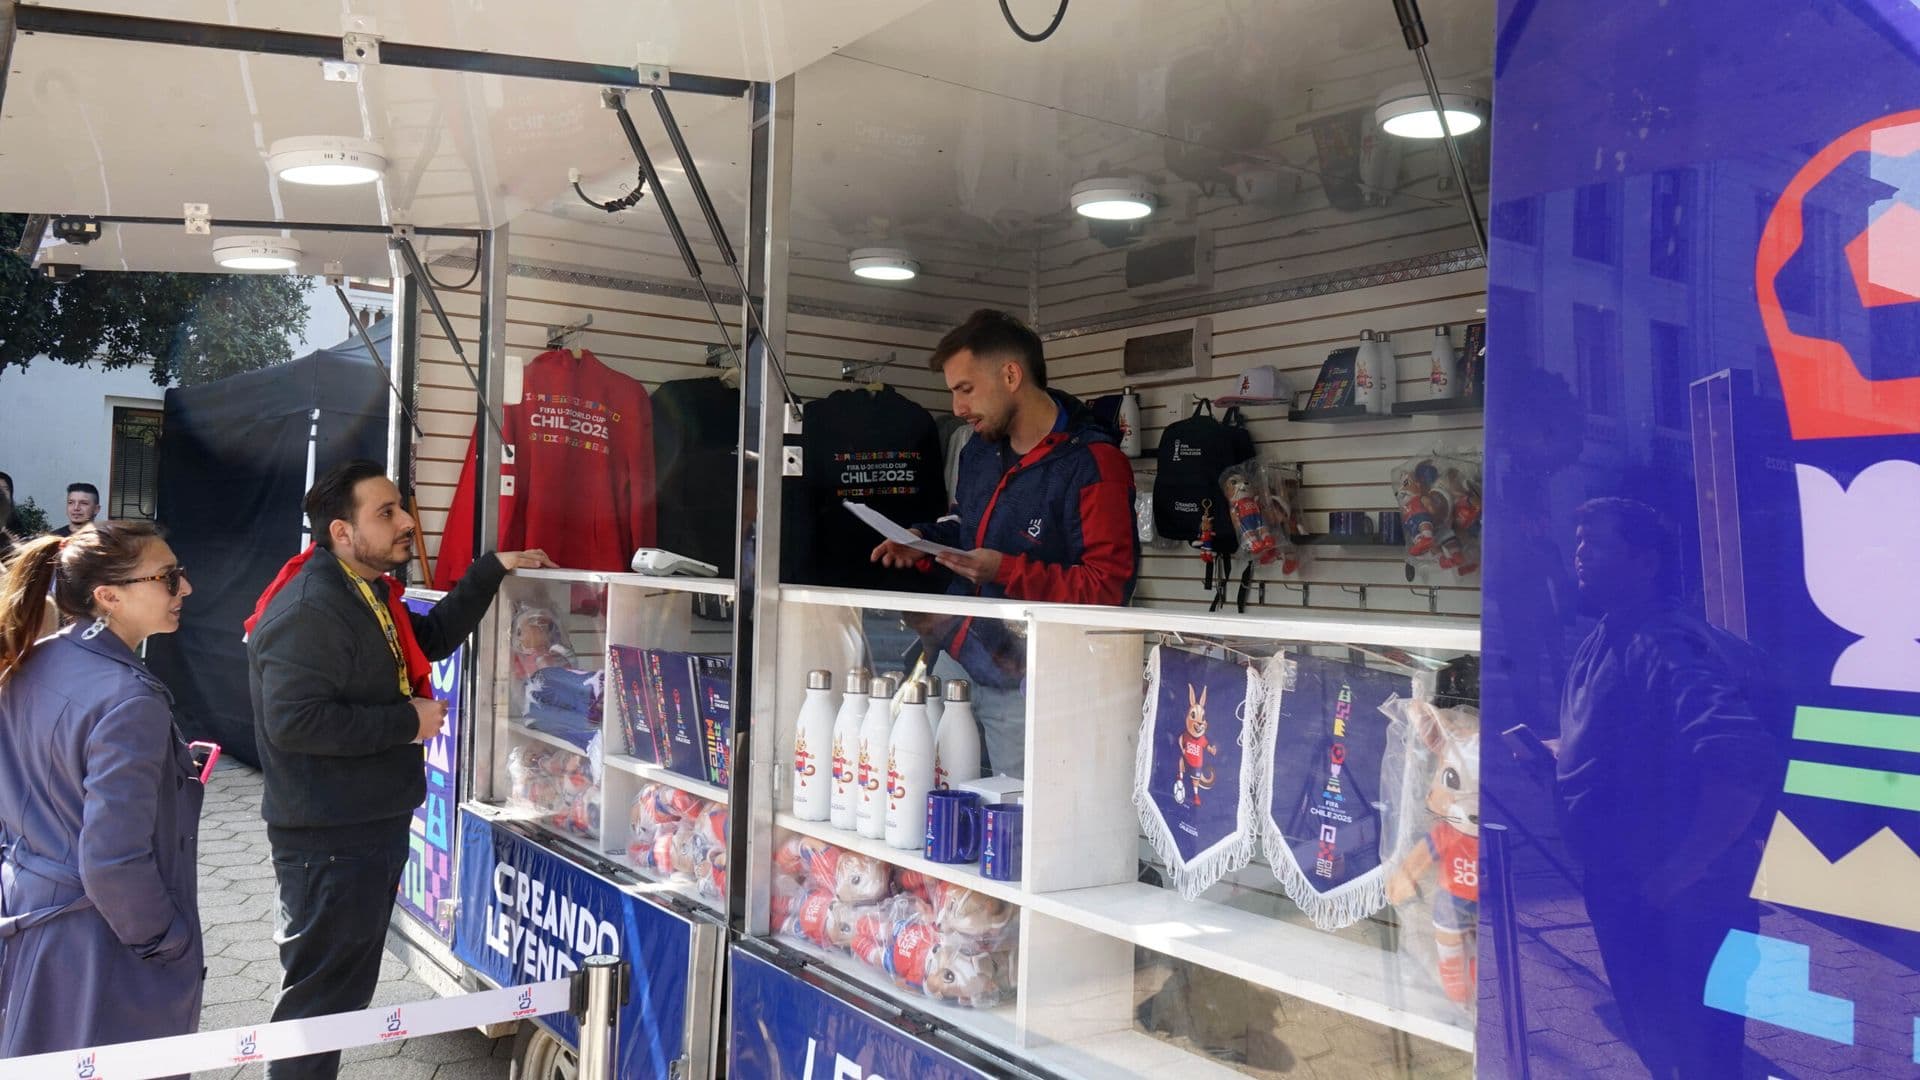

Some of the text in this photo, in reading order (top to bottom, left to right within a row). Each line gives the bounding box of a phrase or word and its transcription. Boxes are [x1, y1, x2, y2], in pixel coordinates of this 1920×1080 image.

[540, 406, 607, 423] FIFA U-2 ORLD CUP
[1325, 800, 1339, 808] FIFA
[494, 861, 619, 957] CREANDO
